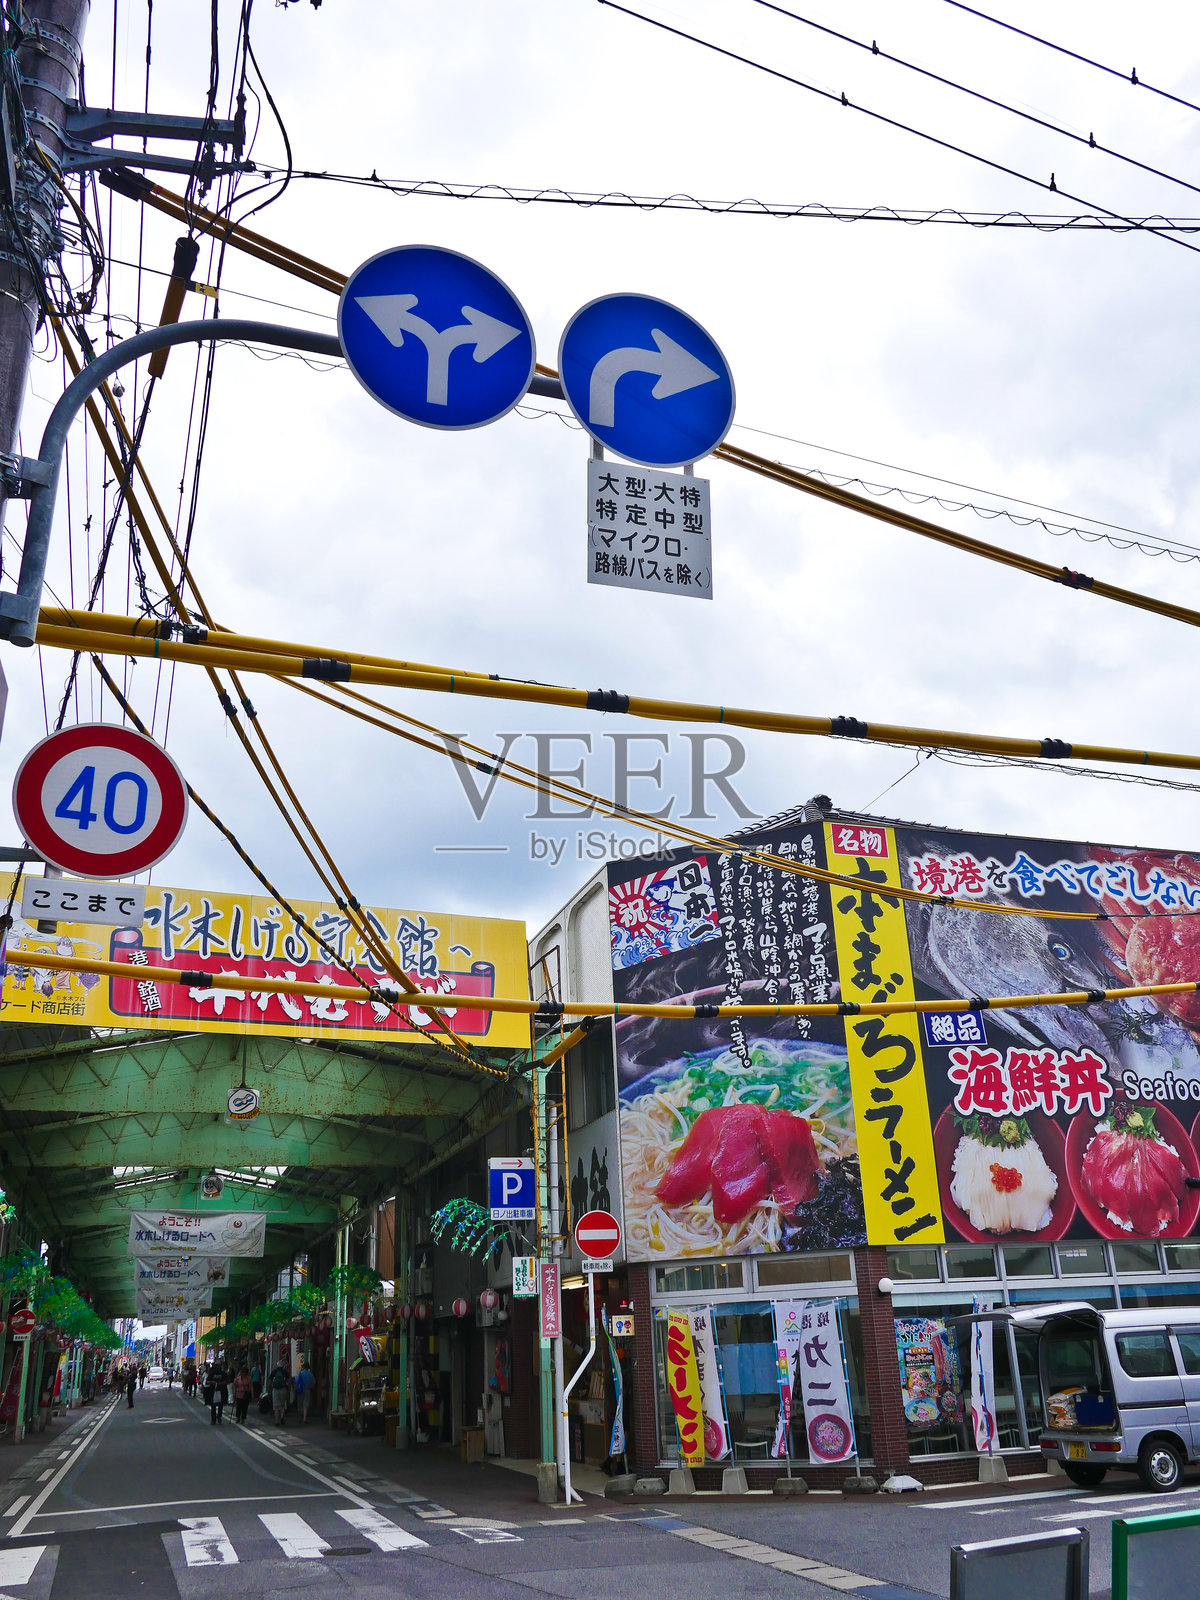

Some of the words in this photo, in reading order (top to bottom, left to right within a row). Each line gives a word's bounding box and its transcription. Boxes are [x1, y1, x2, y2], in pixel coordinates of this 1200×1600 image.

[595, 498, 703, 535] 特定中型
[55, 765, 148, 835] 40
[838, 828, 882, 854] 名物
[32, 889, 136, 916] ここまで
[618, 898, 648, 928] 祝
[128, 949, 162, 1013] 港銘酒
[930, 1013, 982, 1043] 絶品
[950, 1049, 1112, 1115] 海鮮丼
[502, 1172, 523, 1205] P
[134, 1230, 216, 1242] 水木しげるロードへ
